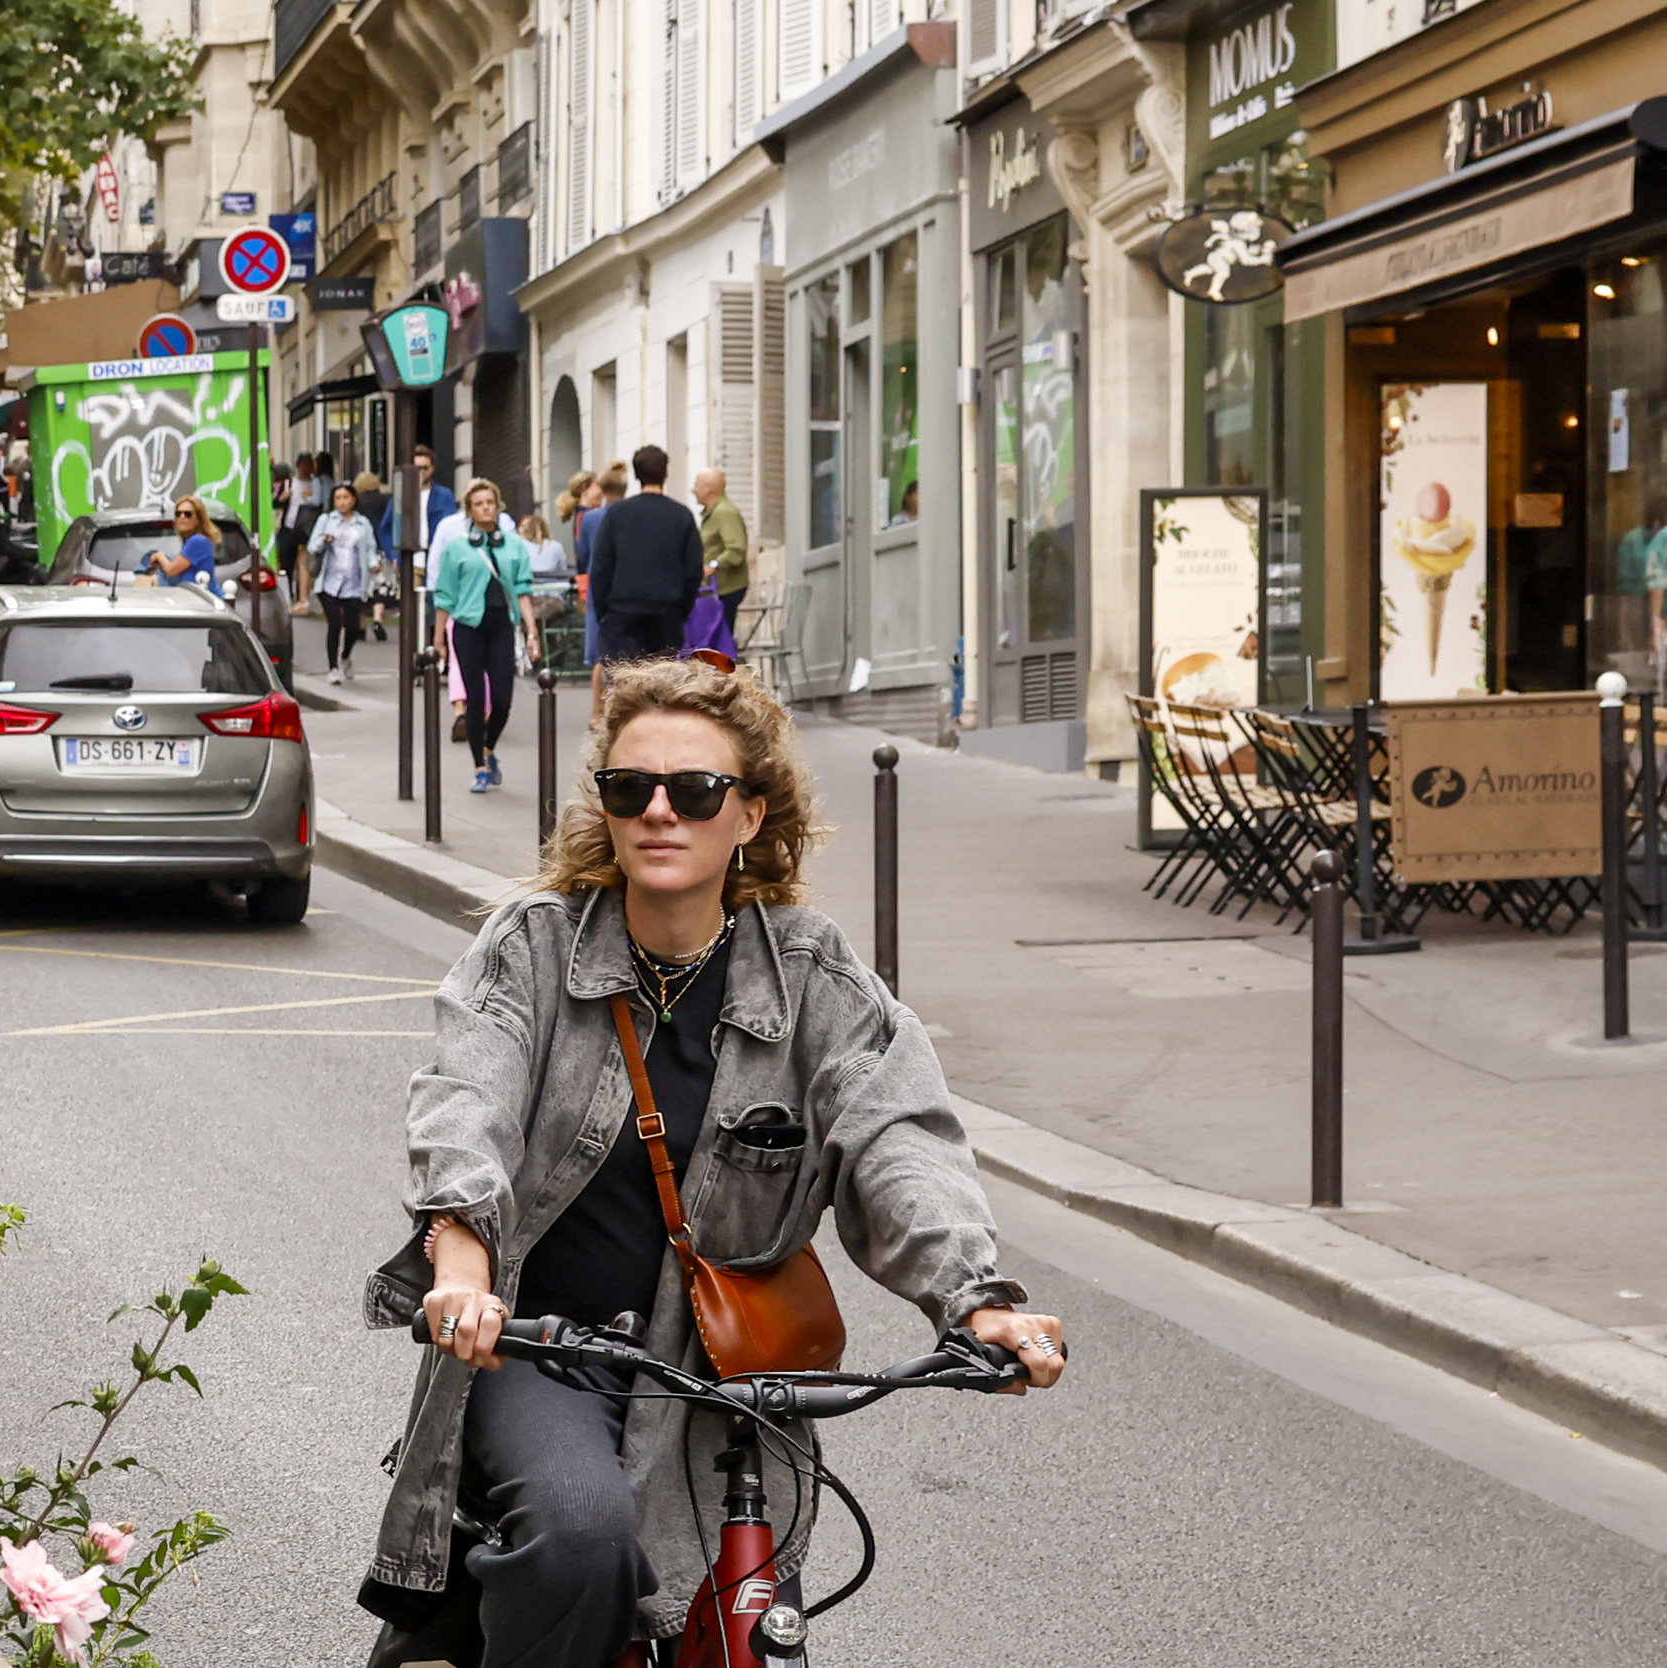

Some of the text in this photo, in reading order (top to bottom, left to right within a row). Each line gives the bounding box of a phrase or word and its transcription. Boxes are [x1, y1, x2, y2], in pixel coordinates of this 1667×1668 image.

[1208, 2, 1296, 108] MOMUS
[223, 302, 265, 316] SAUF
[92, 355, 211, 378] DRON LOCATION
[79, 740, 176, 761] DS-661-ZY
[1471, 765, 1597, 795] Amorino
